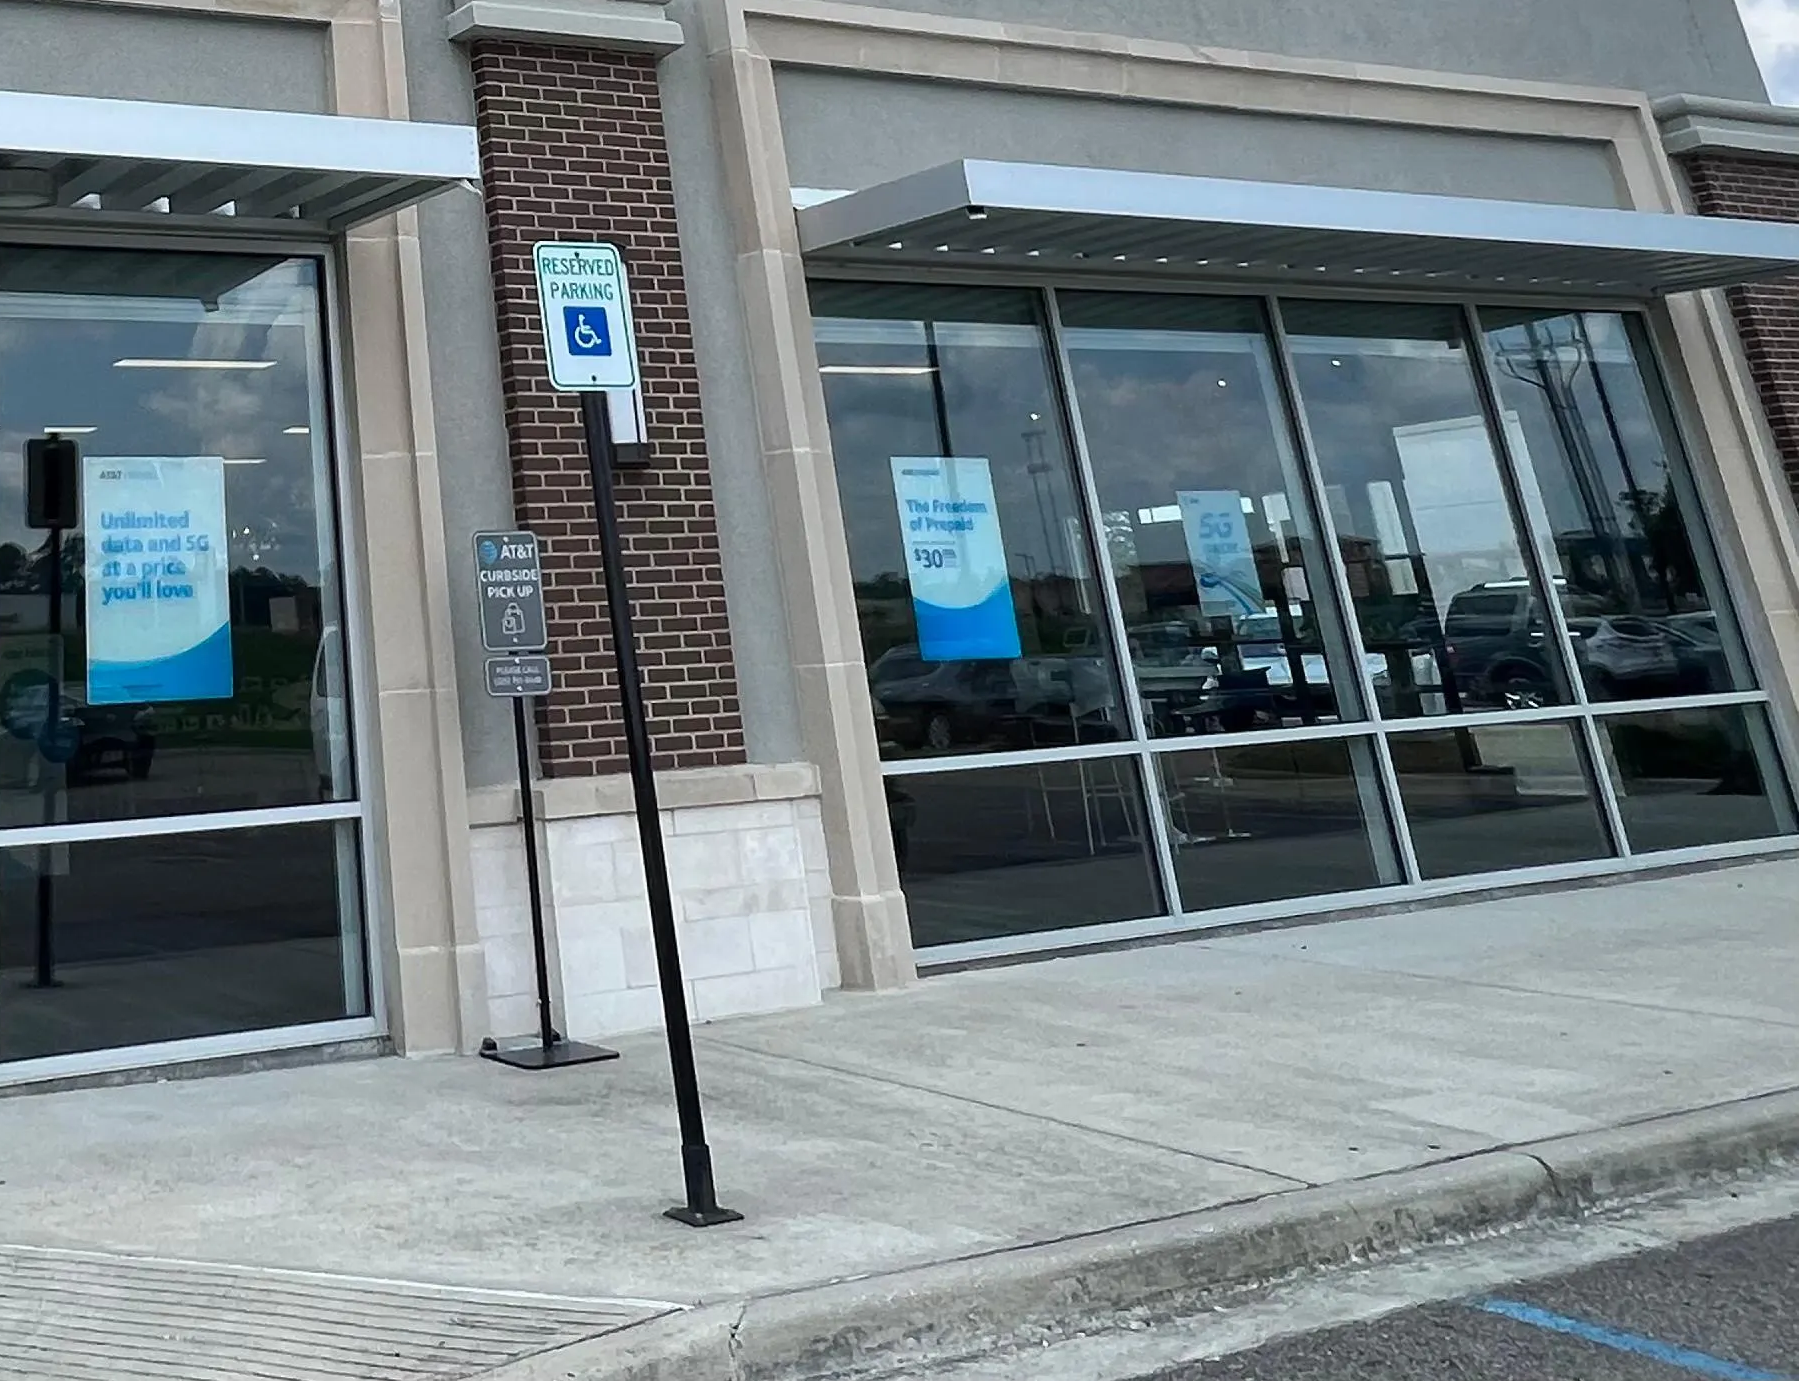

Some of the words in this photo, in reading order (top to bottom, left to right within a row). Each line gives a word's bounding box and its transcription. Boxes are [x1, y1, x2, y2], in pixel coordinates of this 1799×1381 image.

[542, 257, 614, 276] RESERVED
[550, 282, 613, 300] PARKING
[905, 499, 929, 513] The
[932, 499, 988, 513] Freedom
[100, 510, 191, 529] Unlimited
[910, 517, 922, 531] of
[925, 517, 974, 533] Prepaid
[101, 535, 143, 553] data
[147, 534, 181, 552] and
[186, 534, 209, 552] 5G
[500, 544, 534, 560] AT&T
[102, 560, 121, 577] at
[126, 563, 136, 576] a
[142, 557, 186, 580] price
[480, 569, 539, 582] CURBSIDE
[102, 581, 152, 605] you'll
[156, 580, 194, 599] love
[487, 586, 516, 598] PICK
[517, 586, 534, 597] UP
